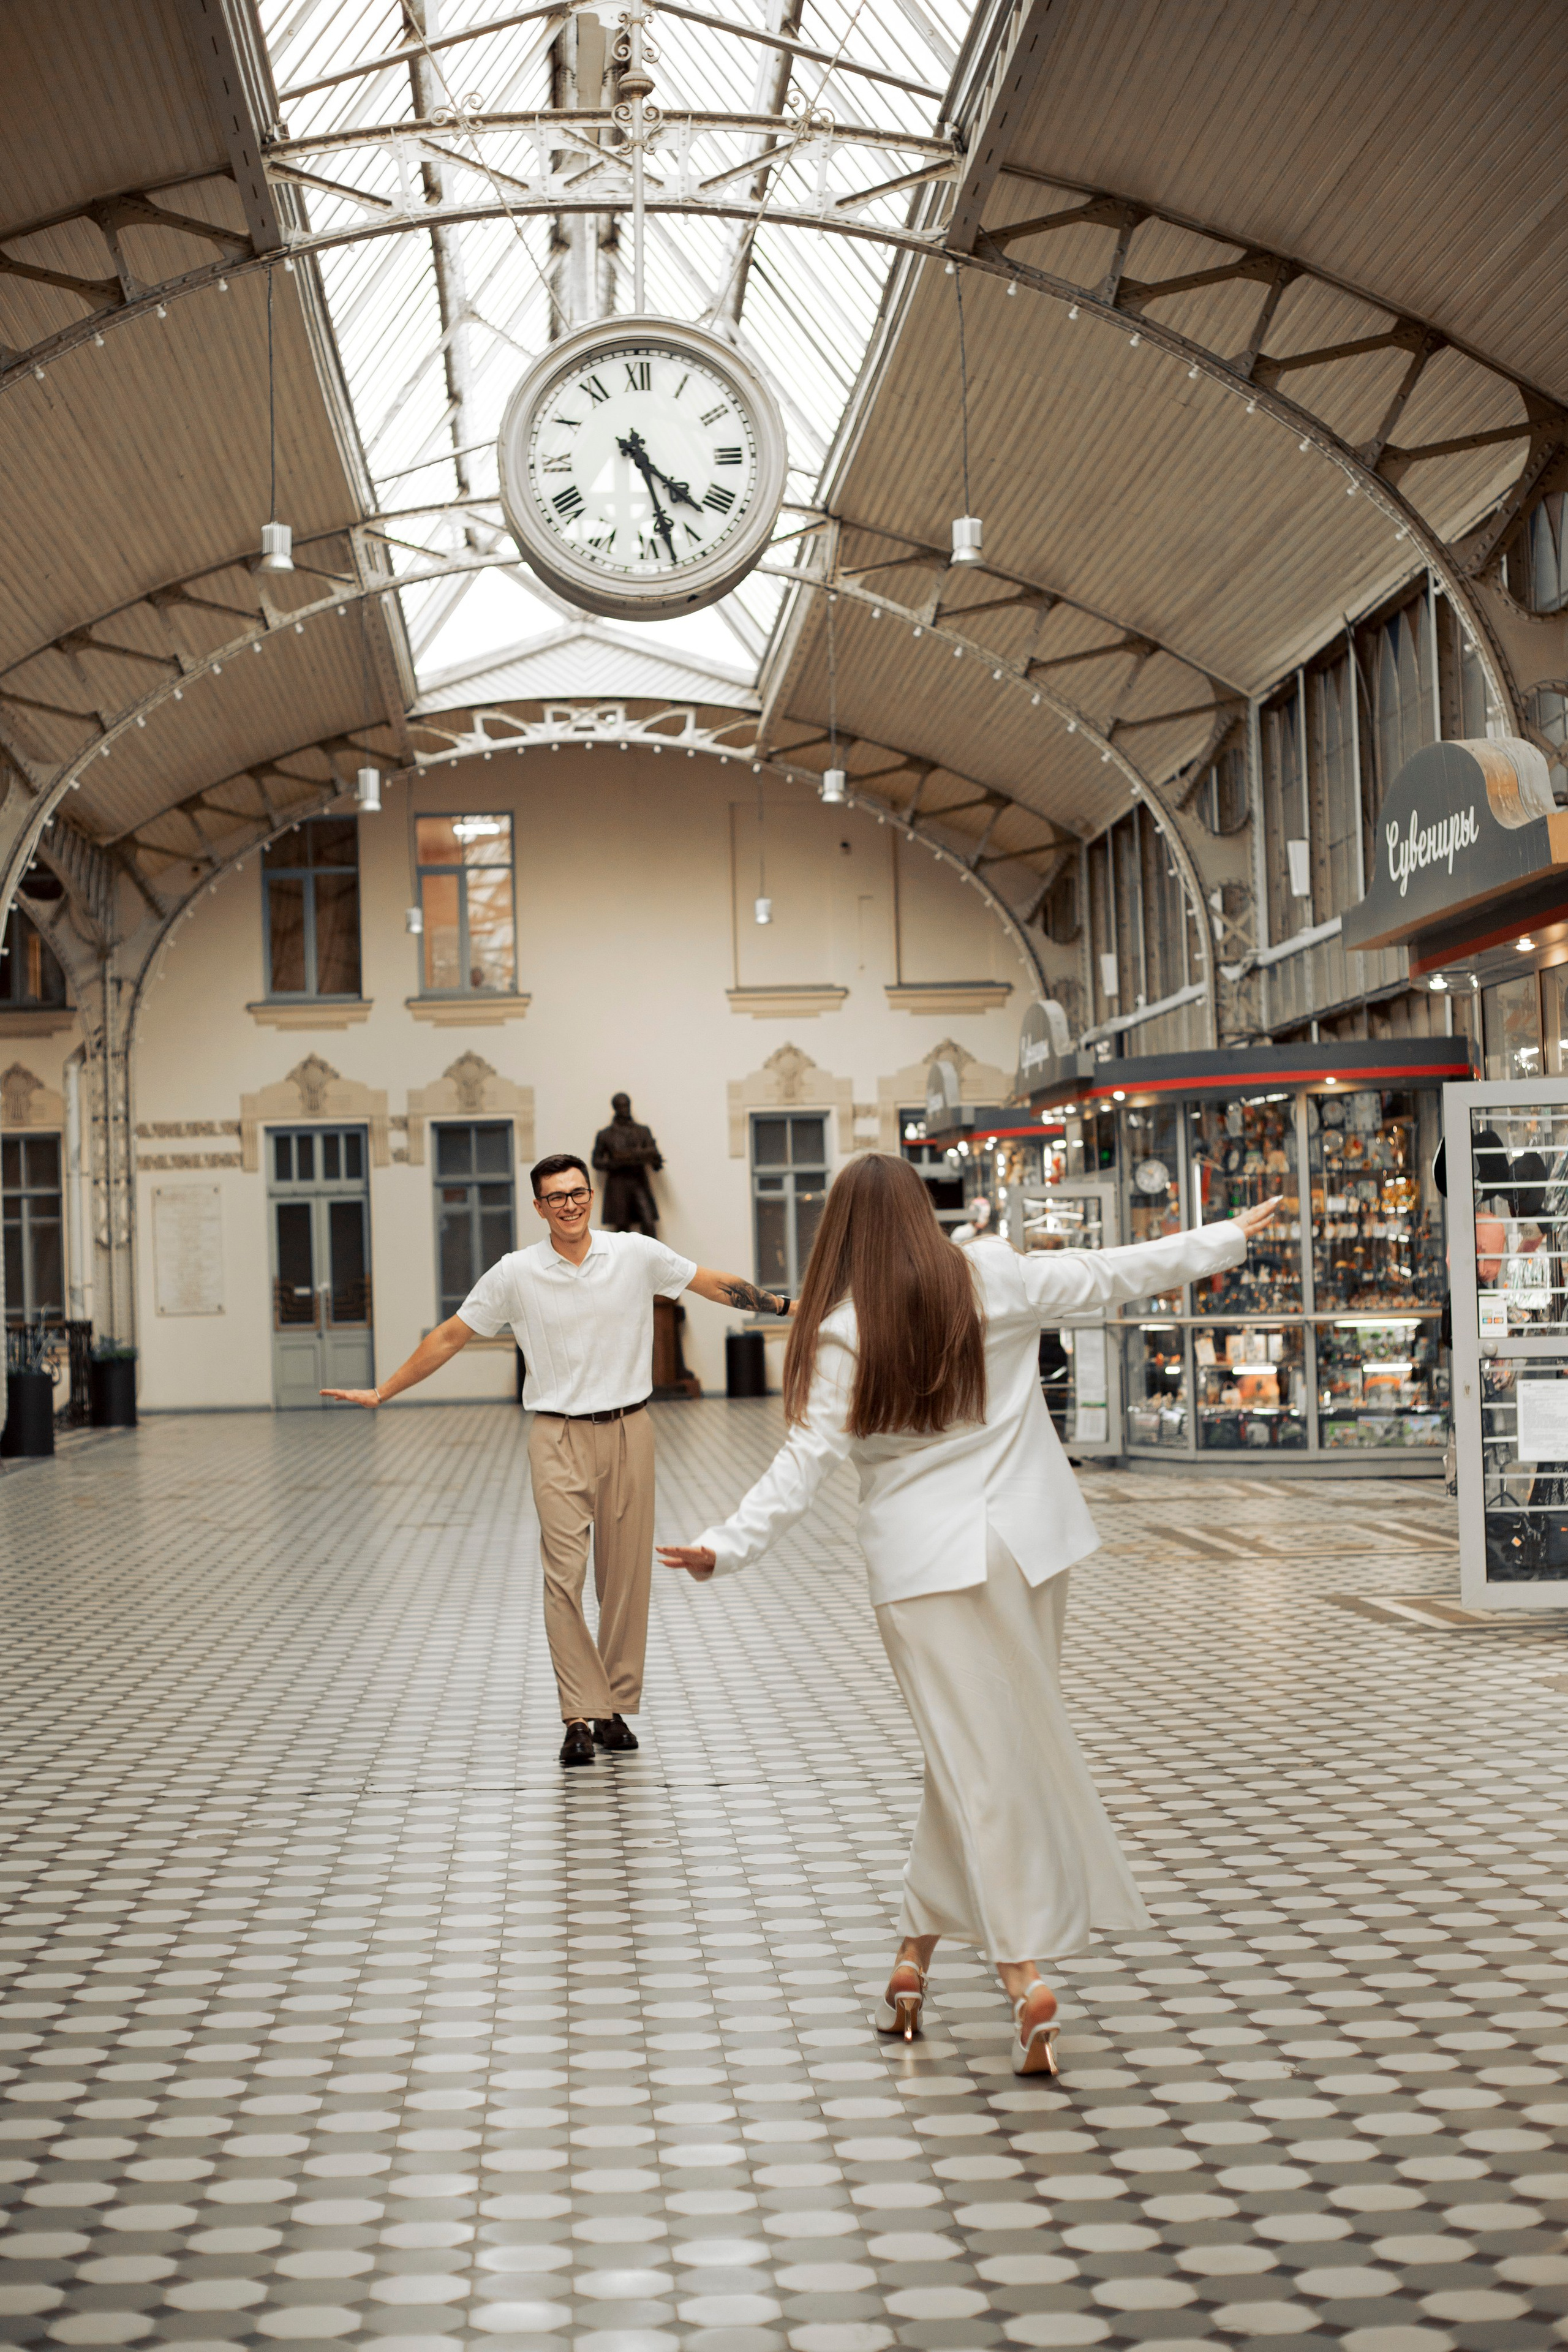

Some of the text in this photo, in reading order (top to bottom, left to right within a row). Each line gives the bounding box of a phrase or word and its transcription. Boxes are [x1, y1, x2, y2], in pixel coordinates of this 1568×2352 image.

[624, 361, 652, 392] XII
[673, 373, 692, 399] I
[576, 374, 611, 409] XI
[552, 409, 582, 435] X
[700, 404, 729, 427] II
[542, 453, 572, 473] IX
[715, 447, 742, 466] III
[552, 485, 587, 525] VIII
[702, 483, 736, 515] IIII
[683, 521, 703, 546] V
[1385, 805, 1480, 898] Сувениры
